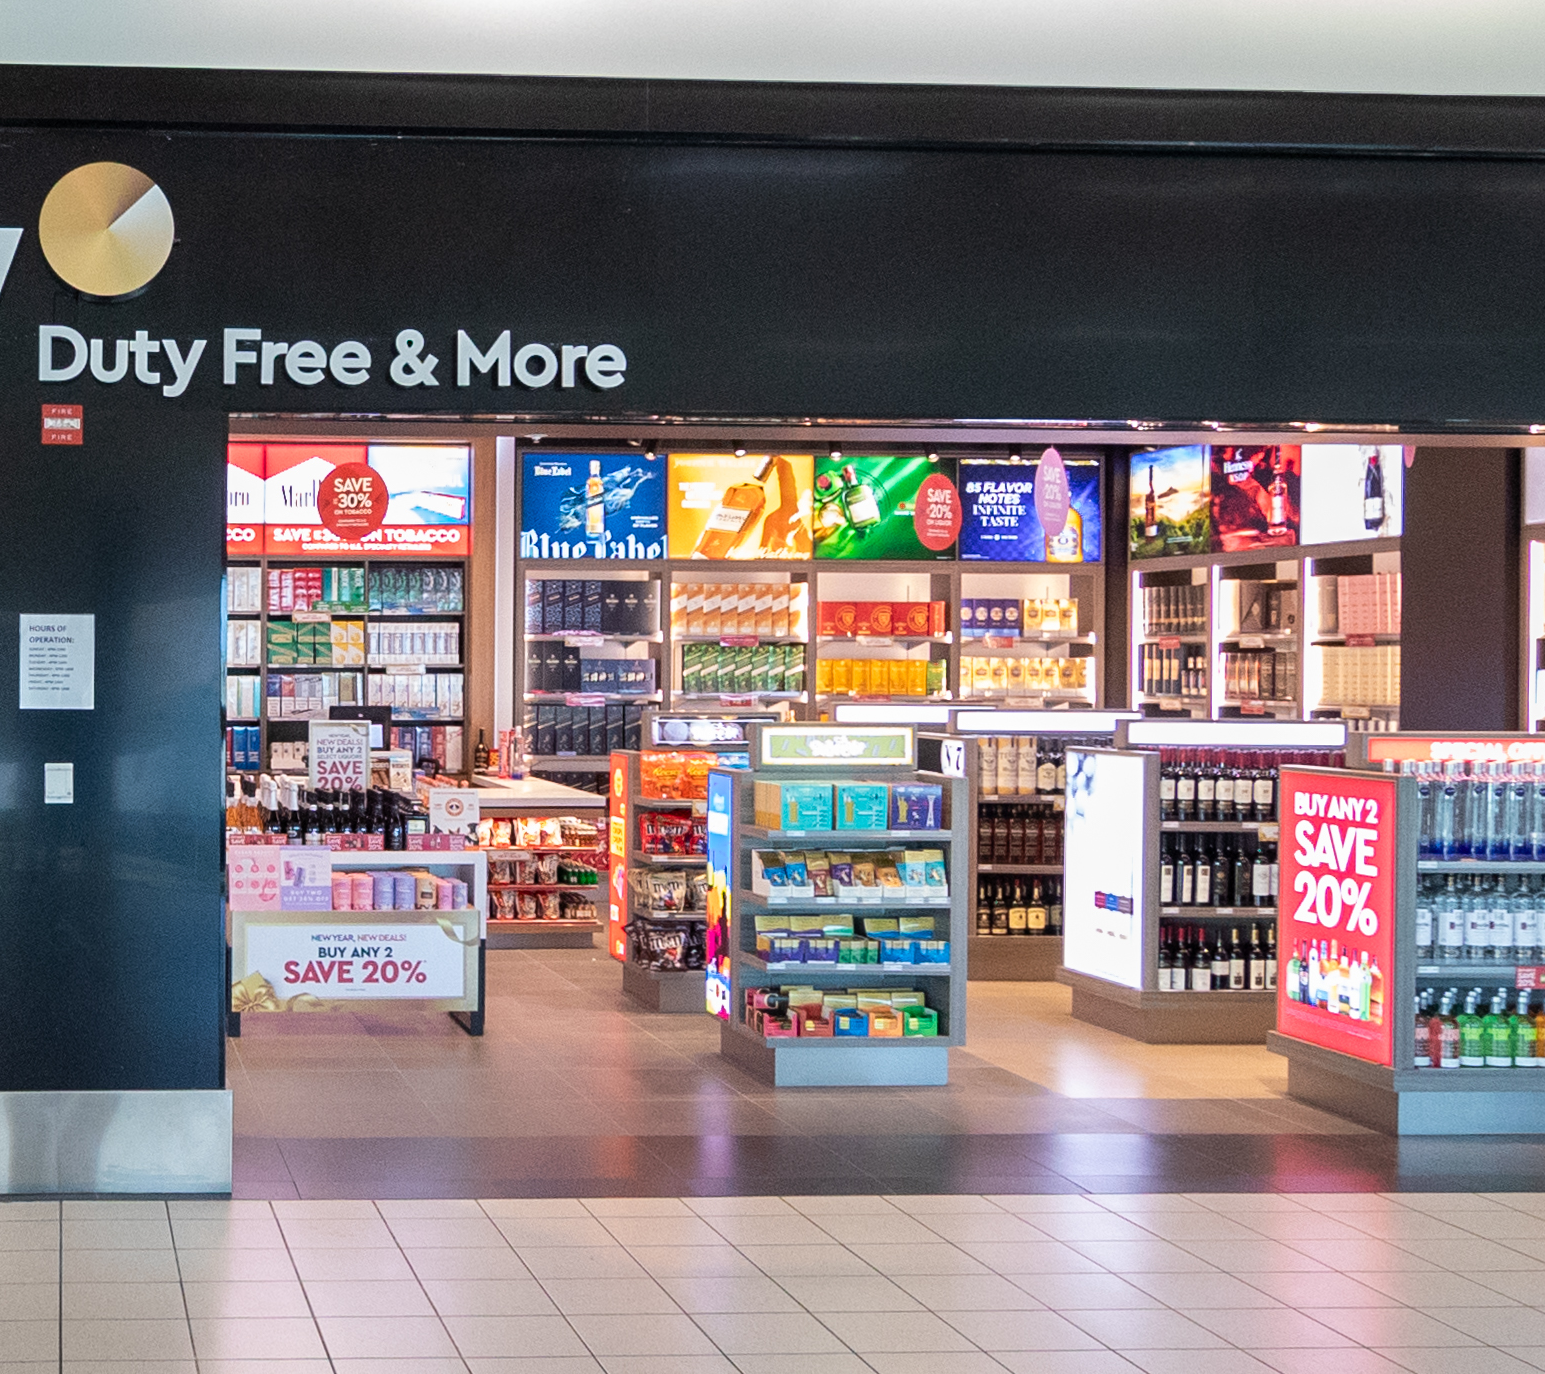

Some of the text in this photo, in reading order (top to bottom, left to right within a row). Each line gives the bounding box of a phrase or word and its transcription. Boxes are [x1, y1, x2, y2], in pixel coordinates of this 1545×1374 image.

[38, 324, 628, 398] Duty Free & More
[51, 408, 73, 416] FIRE
[51, 433, 73, 441] FIRE
[334, 477, 372, 492] SAVE
[965, 482, 1034, 494] 85 FLAVOR
[338, 493, 372, 509] 30%
[927, 488, 953, 504] SAVE
[978, 493, 1021, 505] NOTES
[273, 528, 312, 542] SAVE
[384, 528, 461, 543] TOBACCO
[29, 636, 75, 644] OPERATION:
[337, 738, 362, 746] DEALS!
[336, 746, 355, 754] ANY
[356, 746, 362, 754] 2
[1429, 741, 1507, 761] SPECIAL
[316, 761, 363, 775] SAVE
[317, 776, 363, 790] 20%
[1294, 791, 1379, 824] BUY ANY 2
[1294, 819, 1378, 877] SAVE
[1293, 870, 1378, 937] 20%
[311, 934, 407, 942] NEW YEAR, NEW DEALS!
[318, 946, 393, 958] BUY ANY 2
[284, 960, 354, 984] SAVE
